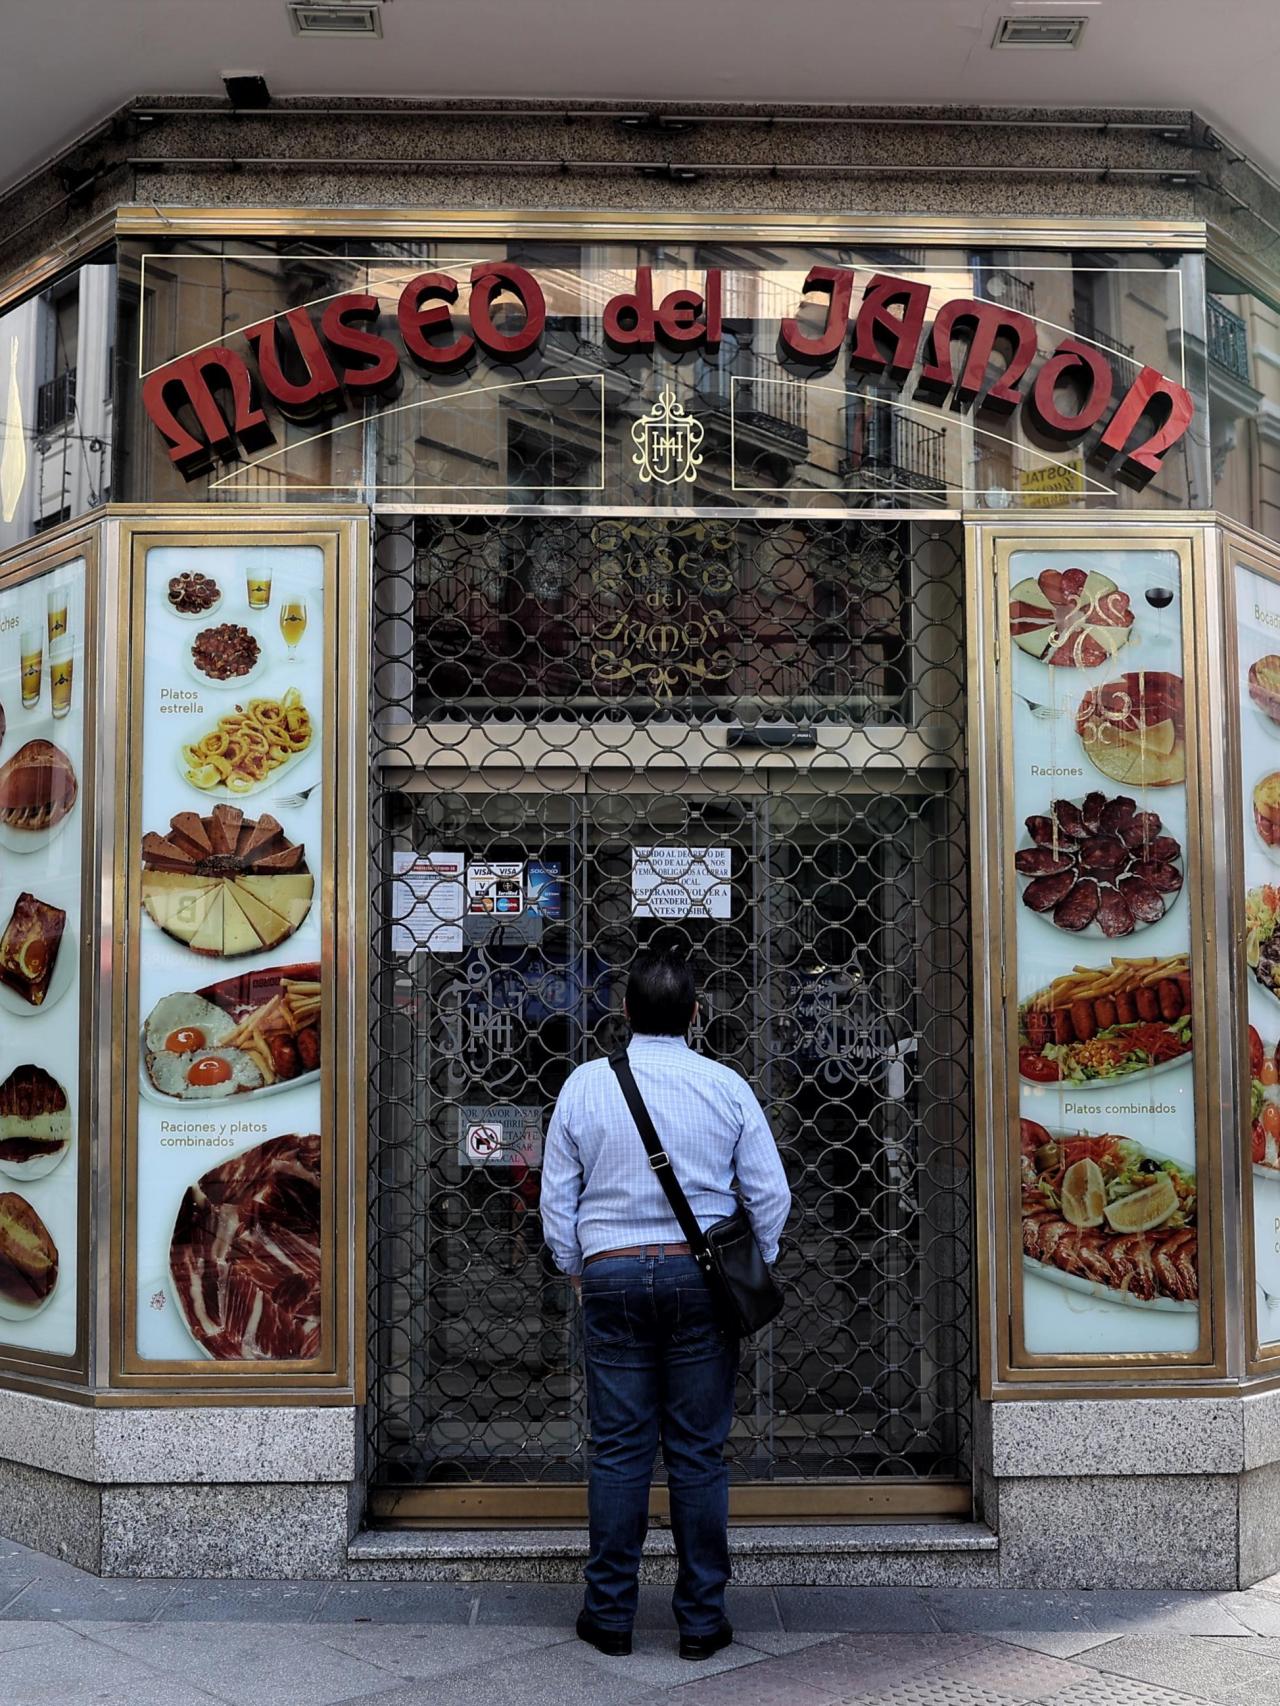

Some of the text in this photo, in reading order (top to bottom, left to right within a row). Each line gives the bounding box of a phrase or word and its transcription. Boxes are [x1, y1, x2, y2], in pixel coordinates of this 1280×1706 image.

[603, 266, 721, 345] del
[160, 688, 199, 699] Platos
[160, 702, 204, 713] estrella
[1031, 765, 1083, 776] Raciones
[474, 868, 493, 876] VISA
[1065, 1102, 1177, 1114] Platos combinados
[160, 1121, 268, 1135] Raciones y platos
[160, 1135, 235, 1146] combinados
